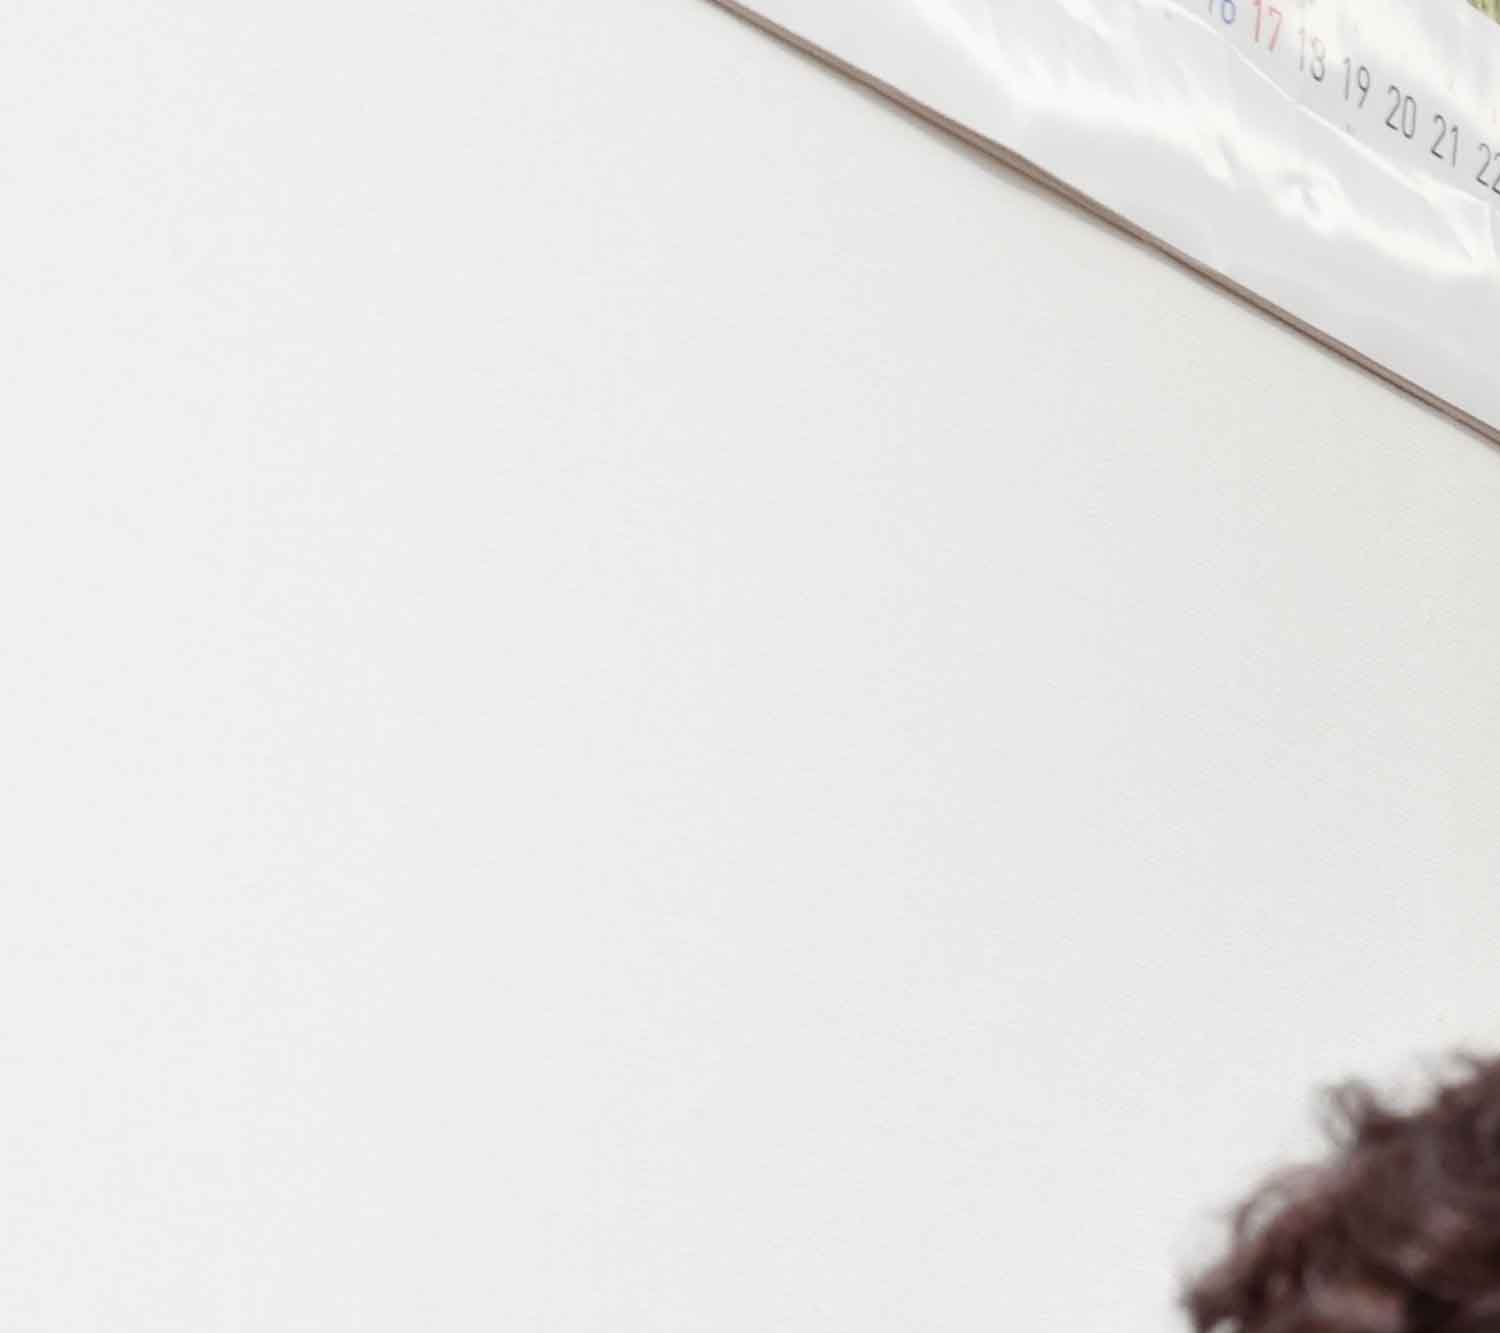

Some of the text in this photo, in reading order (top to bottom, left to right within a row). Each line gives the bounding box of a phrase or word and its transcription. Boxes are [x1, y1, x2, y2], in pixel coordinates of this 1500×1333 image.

[1253, 0, 1283, 51] 17
[1300, 28, 1326, 83] 18
[1344, 57, 1371, 110] 19
[1385, 85, 1417, 139] 20
[1431, 114, 1459, 169] 21
